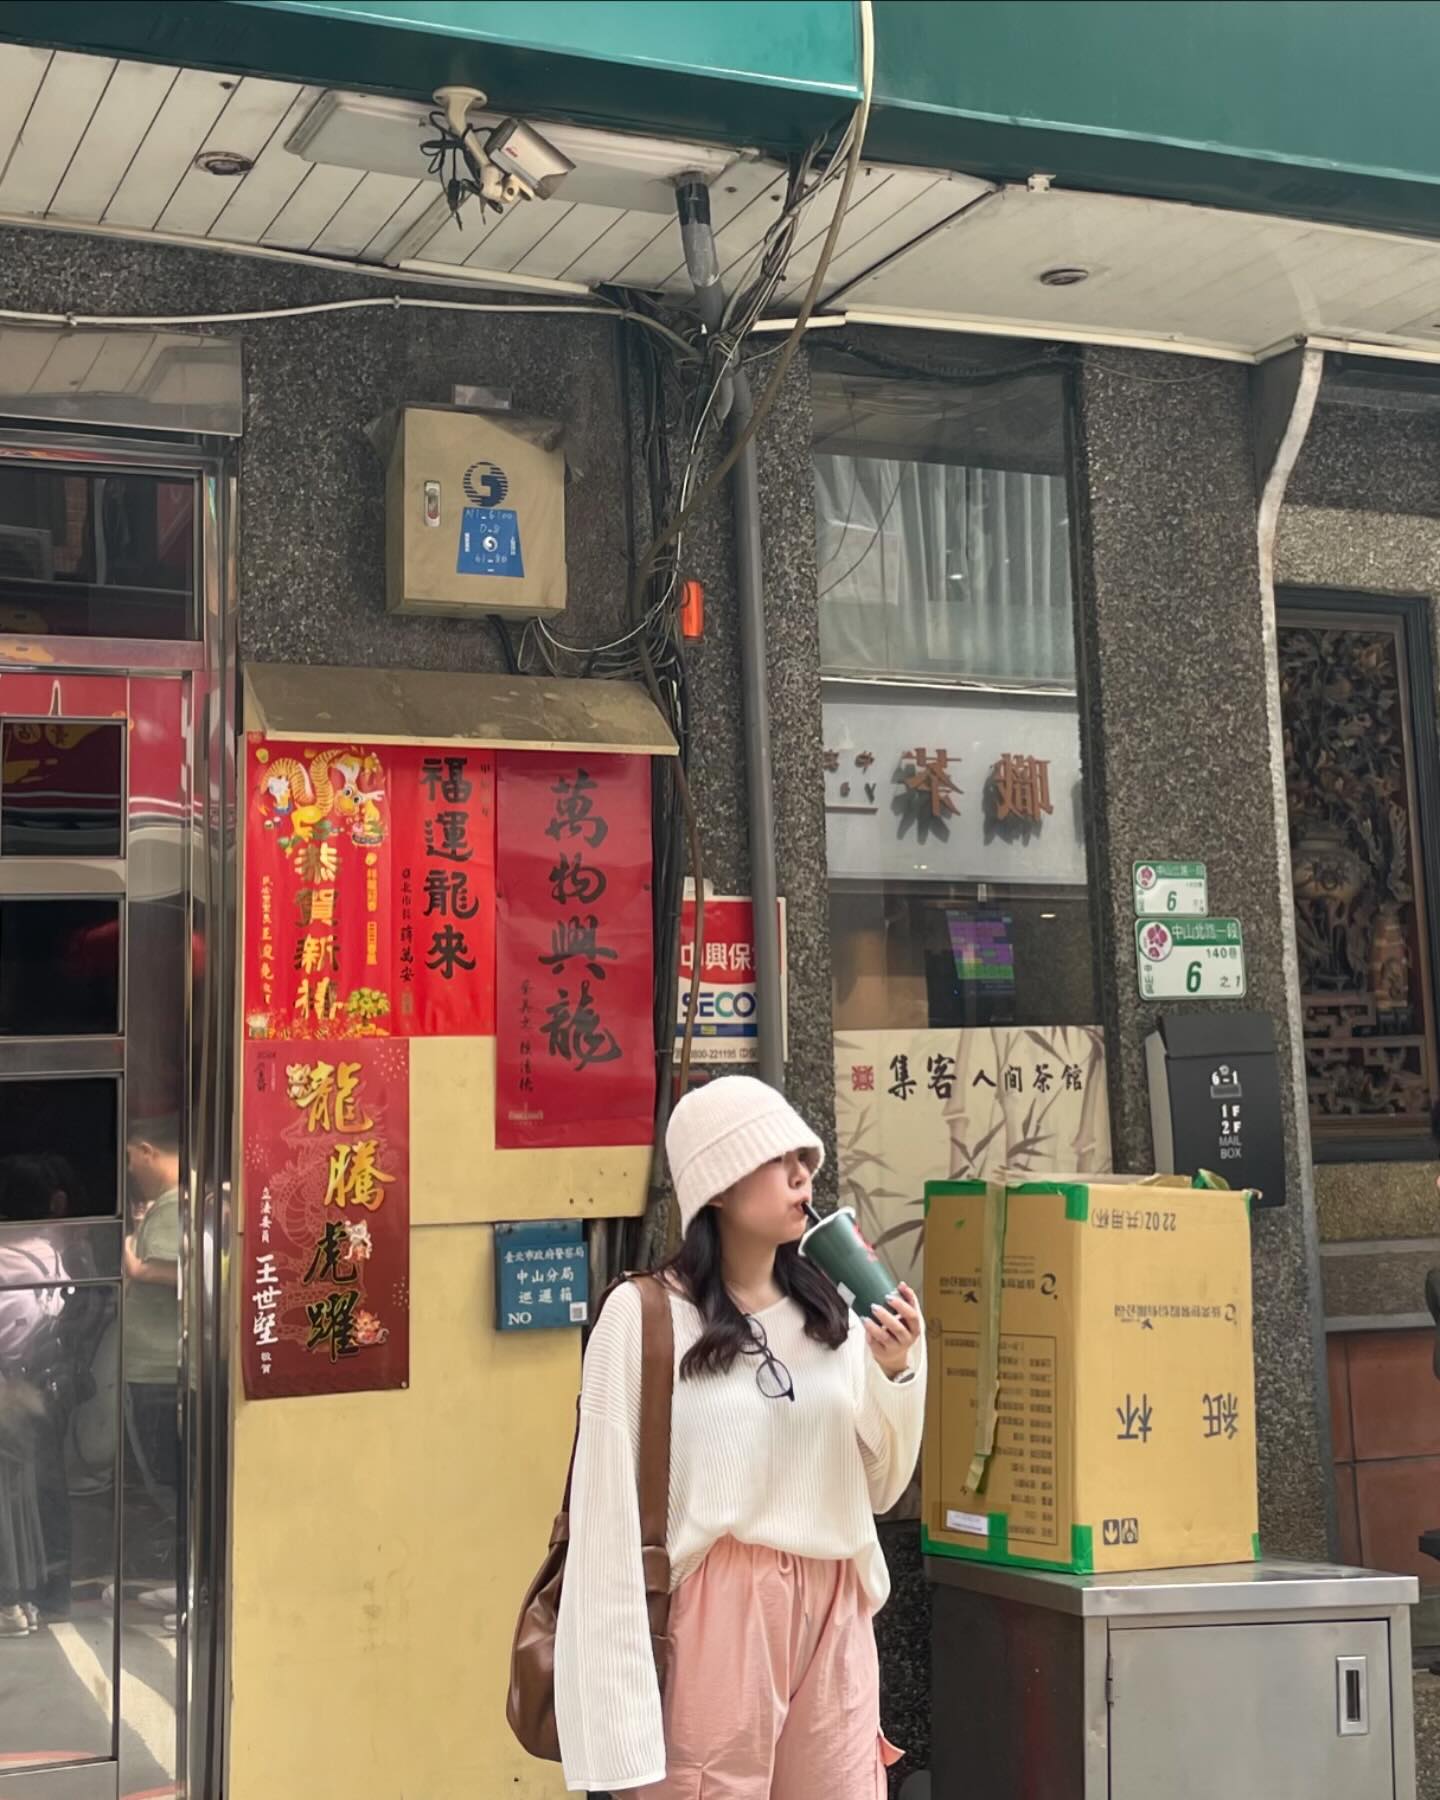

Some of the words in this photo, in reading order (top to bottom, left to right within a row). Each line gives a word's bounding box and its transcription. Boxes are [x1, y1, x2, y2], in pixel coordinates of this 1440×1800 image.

[421, 757, 480, 979] 福運龍來
[1167, 891, 1177, 911] 6
[538, 769, 623, 1071] 萬物興龍
[680, 942, 757, 971] 中興保
[1186, 961, 1202, 993] 6
[682, 991, 757, 1018] SECO
[1211, 1070, 1239, 1086] 6-1
[1218, 1136, 1242, 1147] MAIL
[1220, 1148, 1242, 1159] BOX
[516, 1266, 574, 1285] 中山分局
[252, 1254, 282, 1346] 王世堅
[507, 1312, 532, 1325] NO
